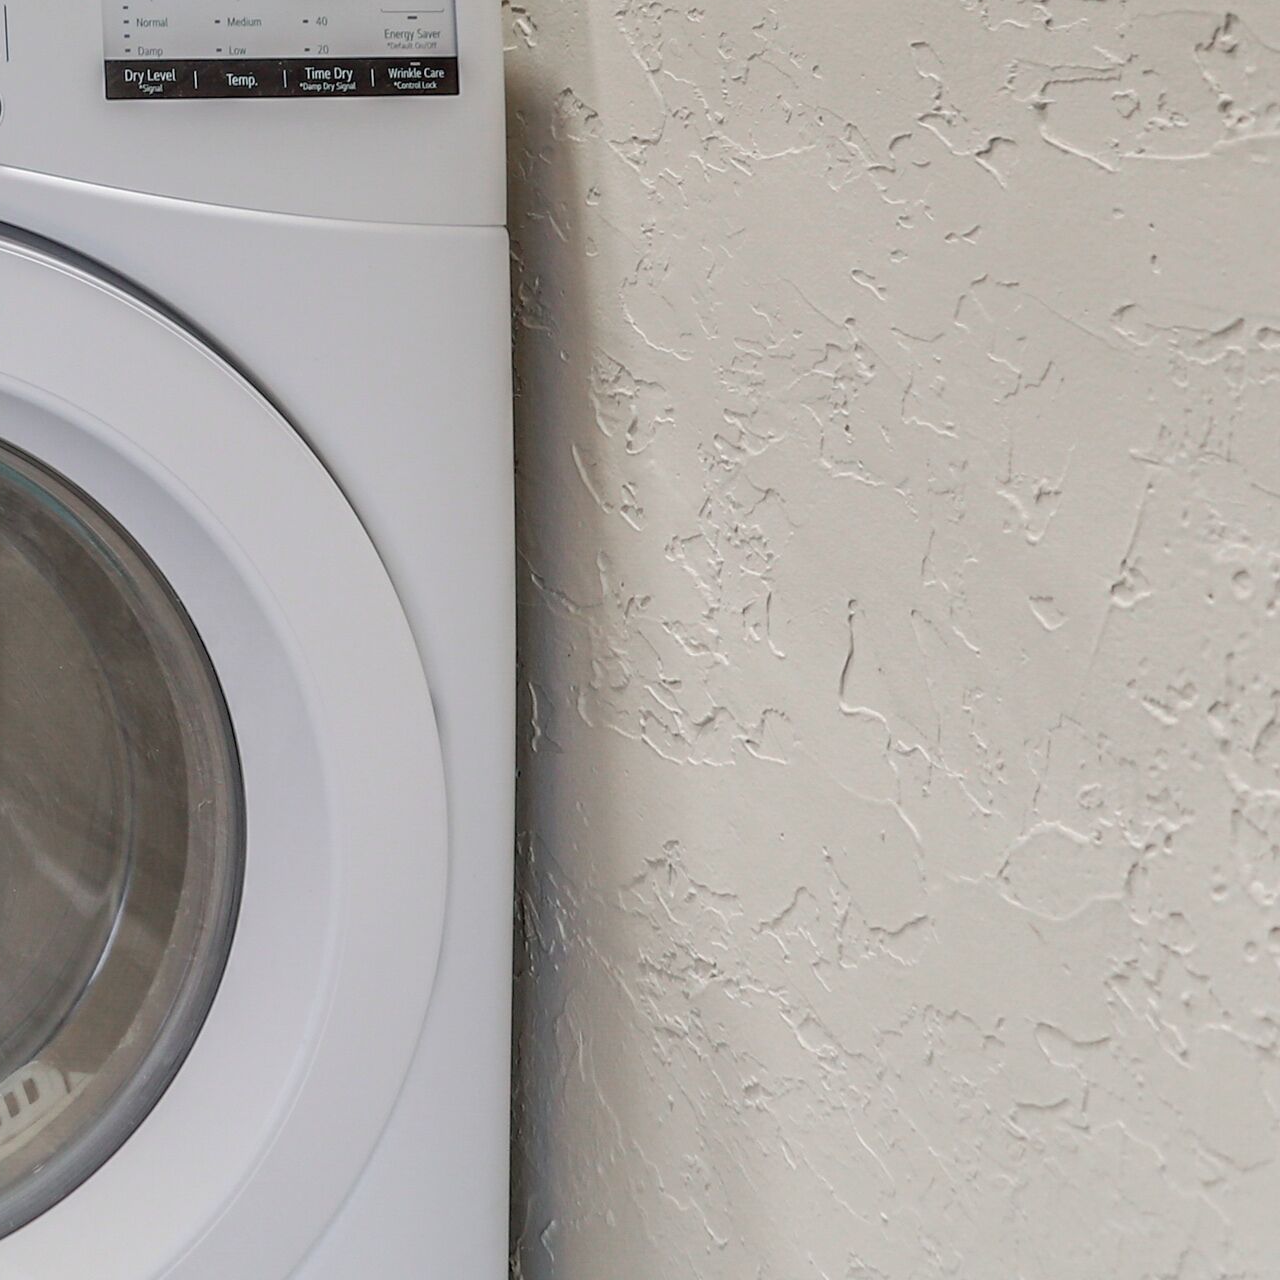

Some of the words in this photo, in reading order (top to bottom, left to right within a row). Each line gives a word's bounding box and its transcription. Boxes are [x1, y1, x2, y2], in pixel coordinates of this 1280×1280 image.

[137, 18, 168, 27] Normal
[228, 18, 262, 27] Medium
[316, 17, 328, 26] 40
[384, 29, 414, 41] Energy
[417, 29, 441, 39] Saver
[138, 47, 163, 57] Damp
[229, 47, 246, 55] Low
[318, 45, 329, 54] 20
[125, 70, 144, 85] Dry
[147, 69, 176, 82] Level
[305, 67, 331, 80] Time
[334, 67, 353, 82] Dry
[388, 68, 422, 78] Wrinkle
[424, 68, 444, 78] Care
[226, 73, 258, 88] Temp.
[422, 81, 437, 89] Lock
[323, 82, 335, 92] Dry
[336, 82, 356, 92] Signal
